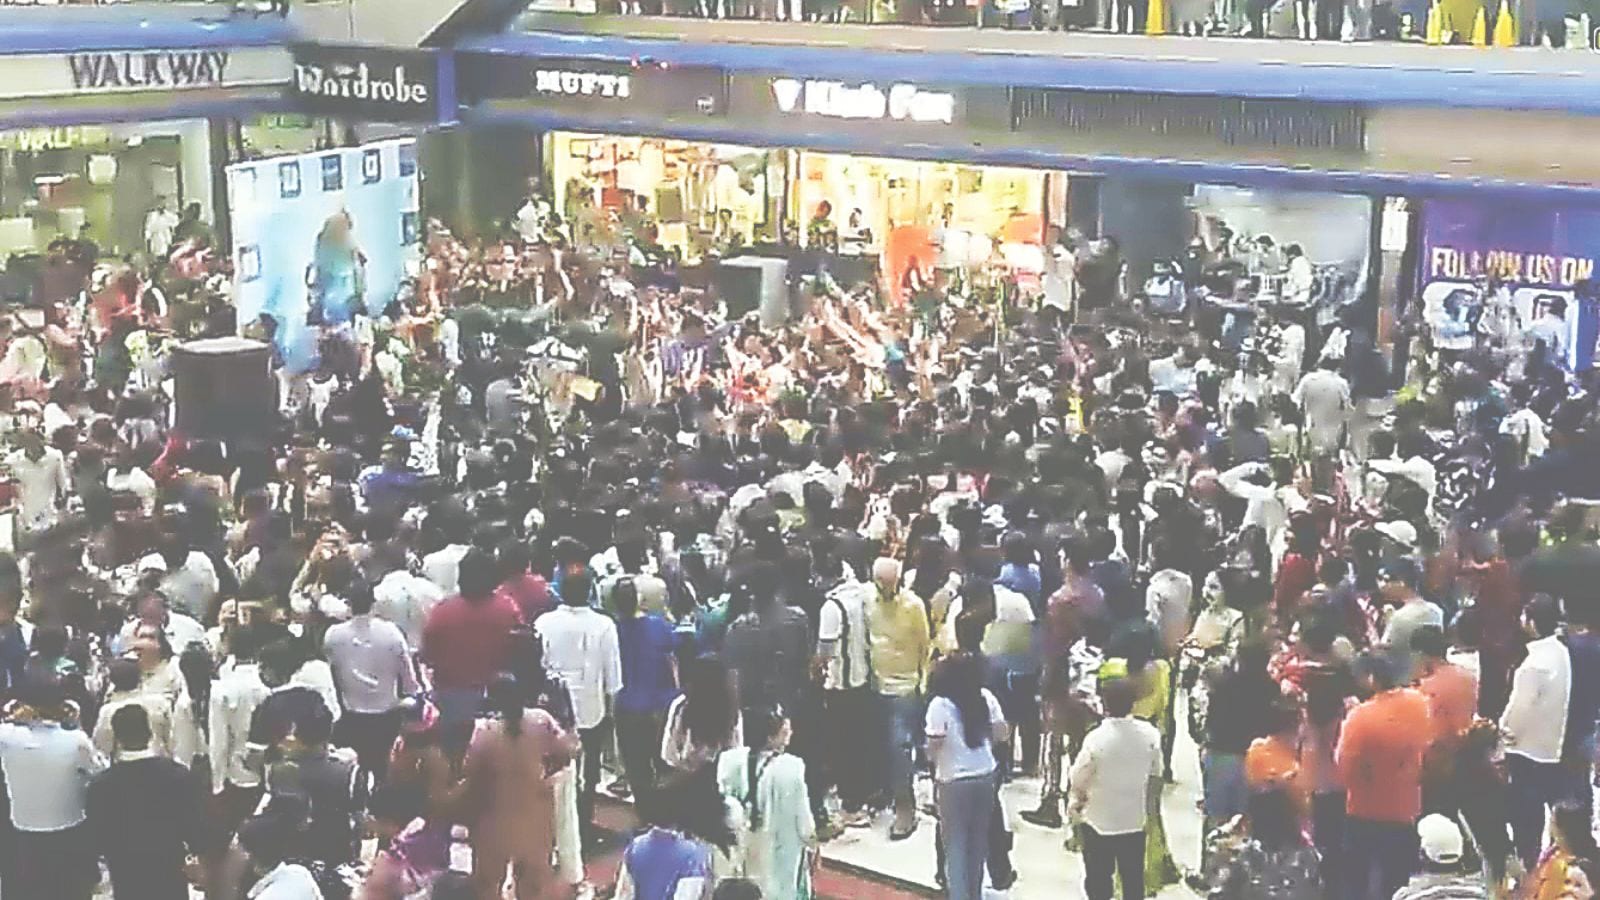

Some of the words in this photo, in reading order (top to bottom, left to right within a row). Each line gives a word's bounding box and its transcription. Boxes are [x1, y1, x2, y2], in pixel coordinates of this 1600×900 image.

[68, 53, 228, 88] WALKWAY
[536, 70, 630, 97] MUFTI
[1527, 253, 1554, 284] US
[1561, 257, 1594, 286] ON
